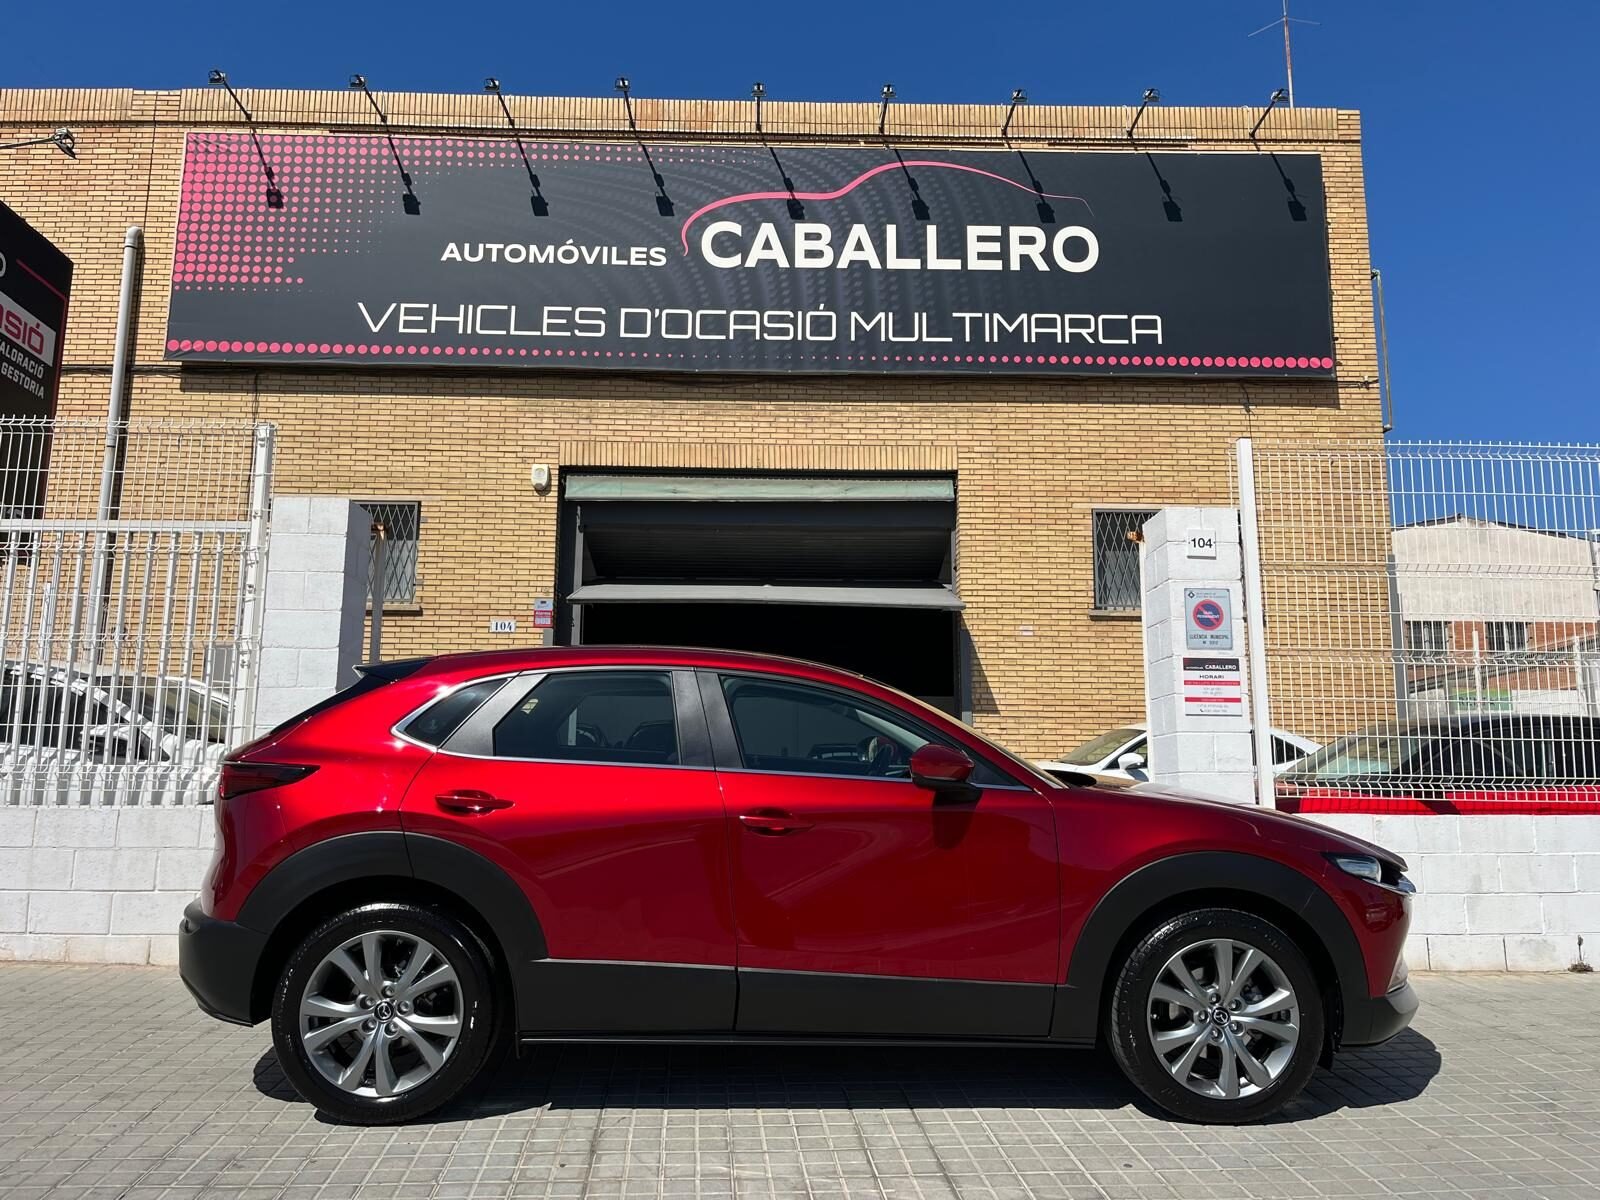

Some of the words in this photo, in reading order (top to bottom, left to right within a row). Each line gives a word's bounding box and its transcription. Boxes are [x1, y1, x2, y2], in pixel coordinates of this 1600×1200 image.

[441, 238, 667, 267] AUTOMÓVILES
[700, 220, 1100, 273] CABALLERO
[357, 302, 606, 338] VEHICLES
[619, 304, 837, 342] D'OCASIÓ
[850, 311, 1164, 345] MULTIMARCA
[1, 361, 45, 400] GESTORIA
[1191, 537, 1213, 549] 104
[495, 621, 512, 631] 104
